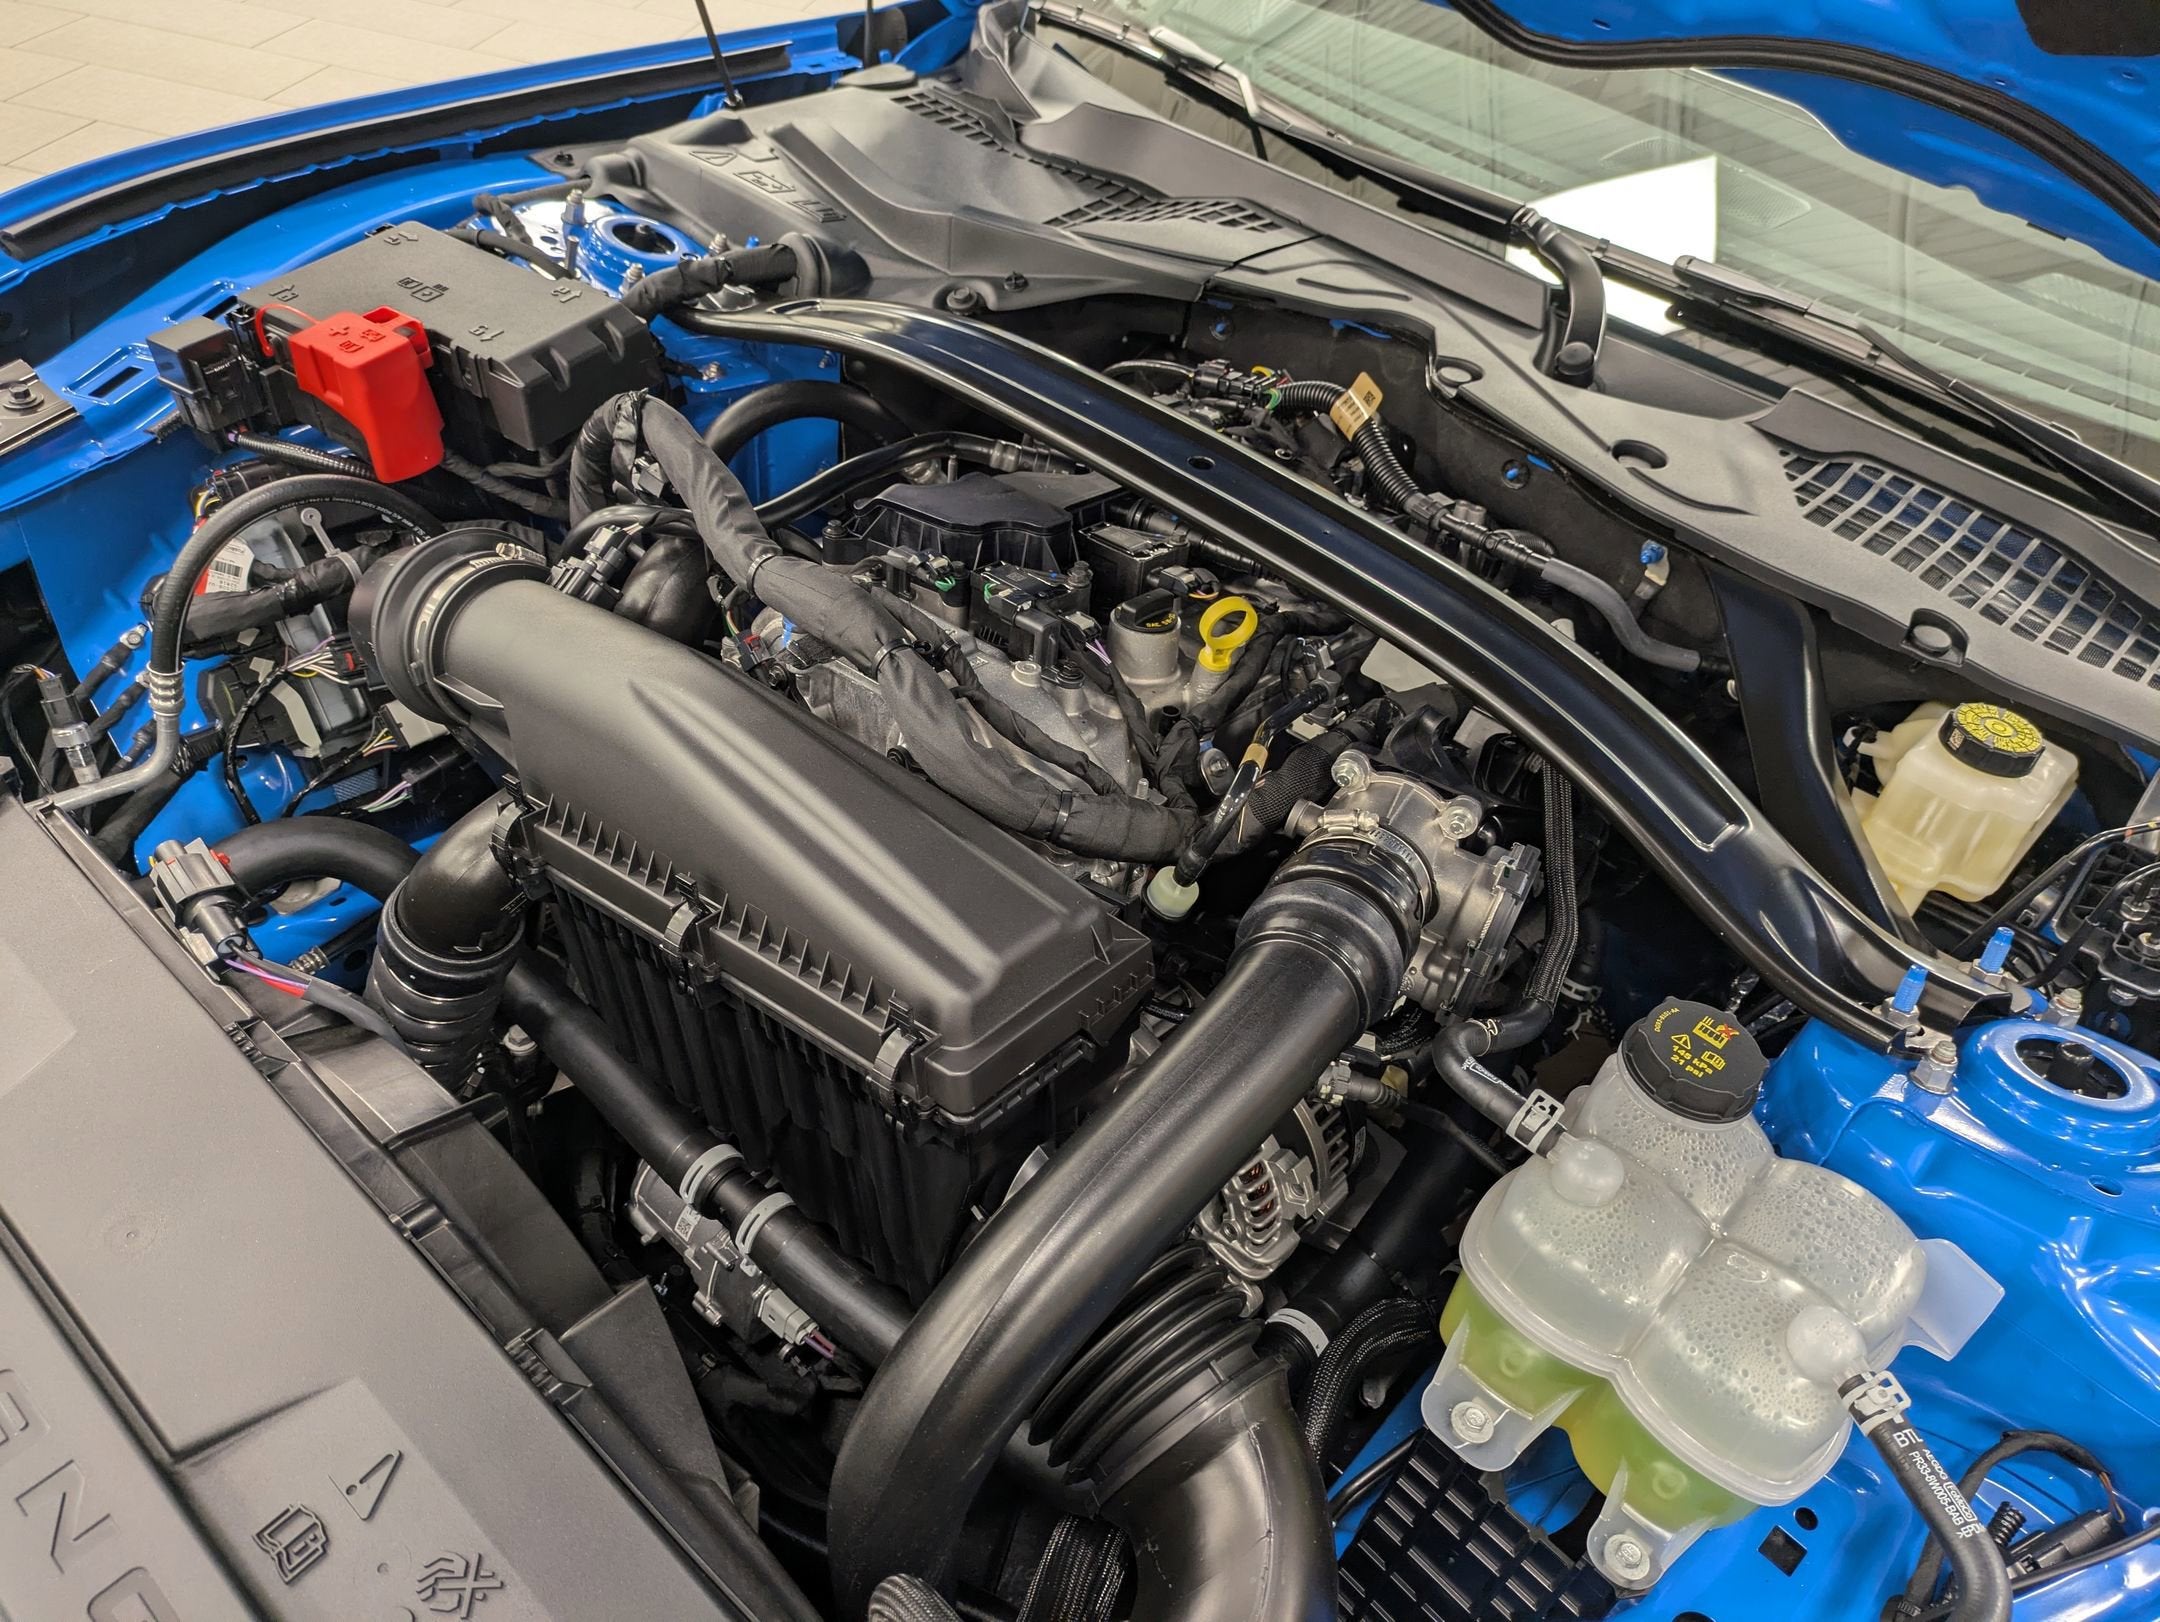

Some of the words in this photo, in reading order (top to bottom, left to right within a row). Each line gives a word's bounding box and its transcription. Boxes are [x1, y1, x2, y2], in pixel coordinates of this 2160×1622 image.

[1670, 1054, 1685, 1066] 21
[1685, 1065, 1704, 1078] psi
[1672, 1045, 1692, 1060] 145
[1692, 1058, 1713, 1075] kPa
